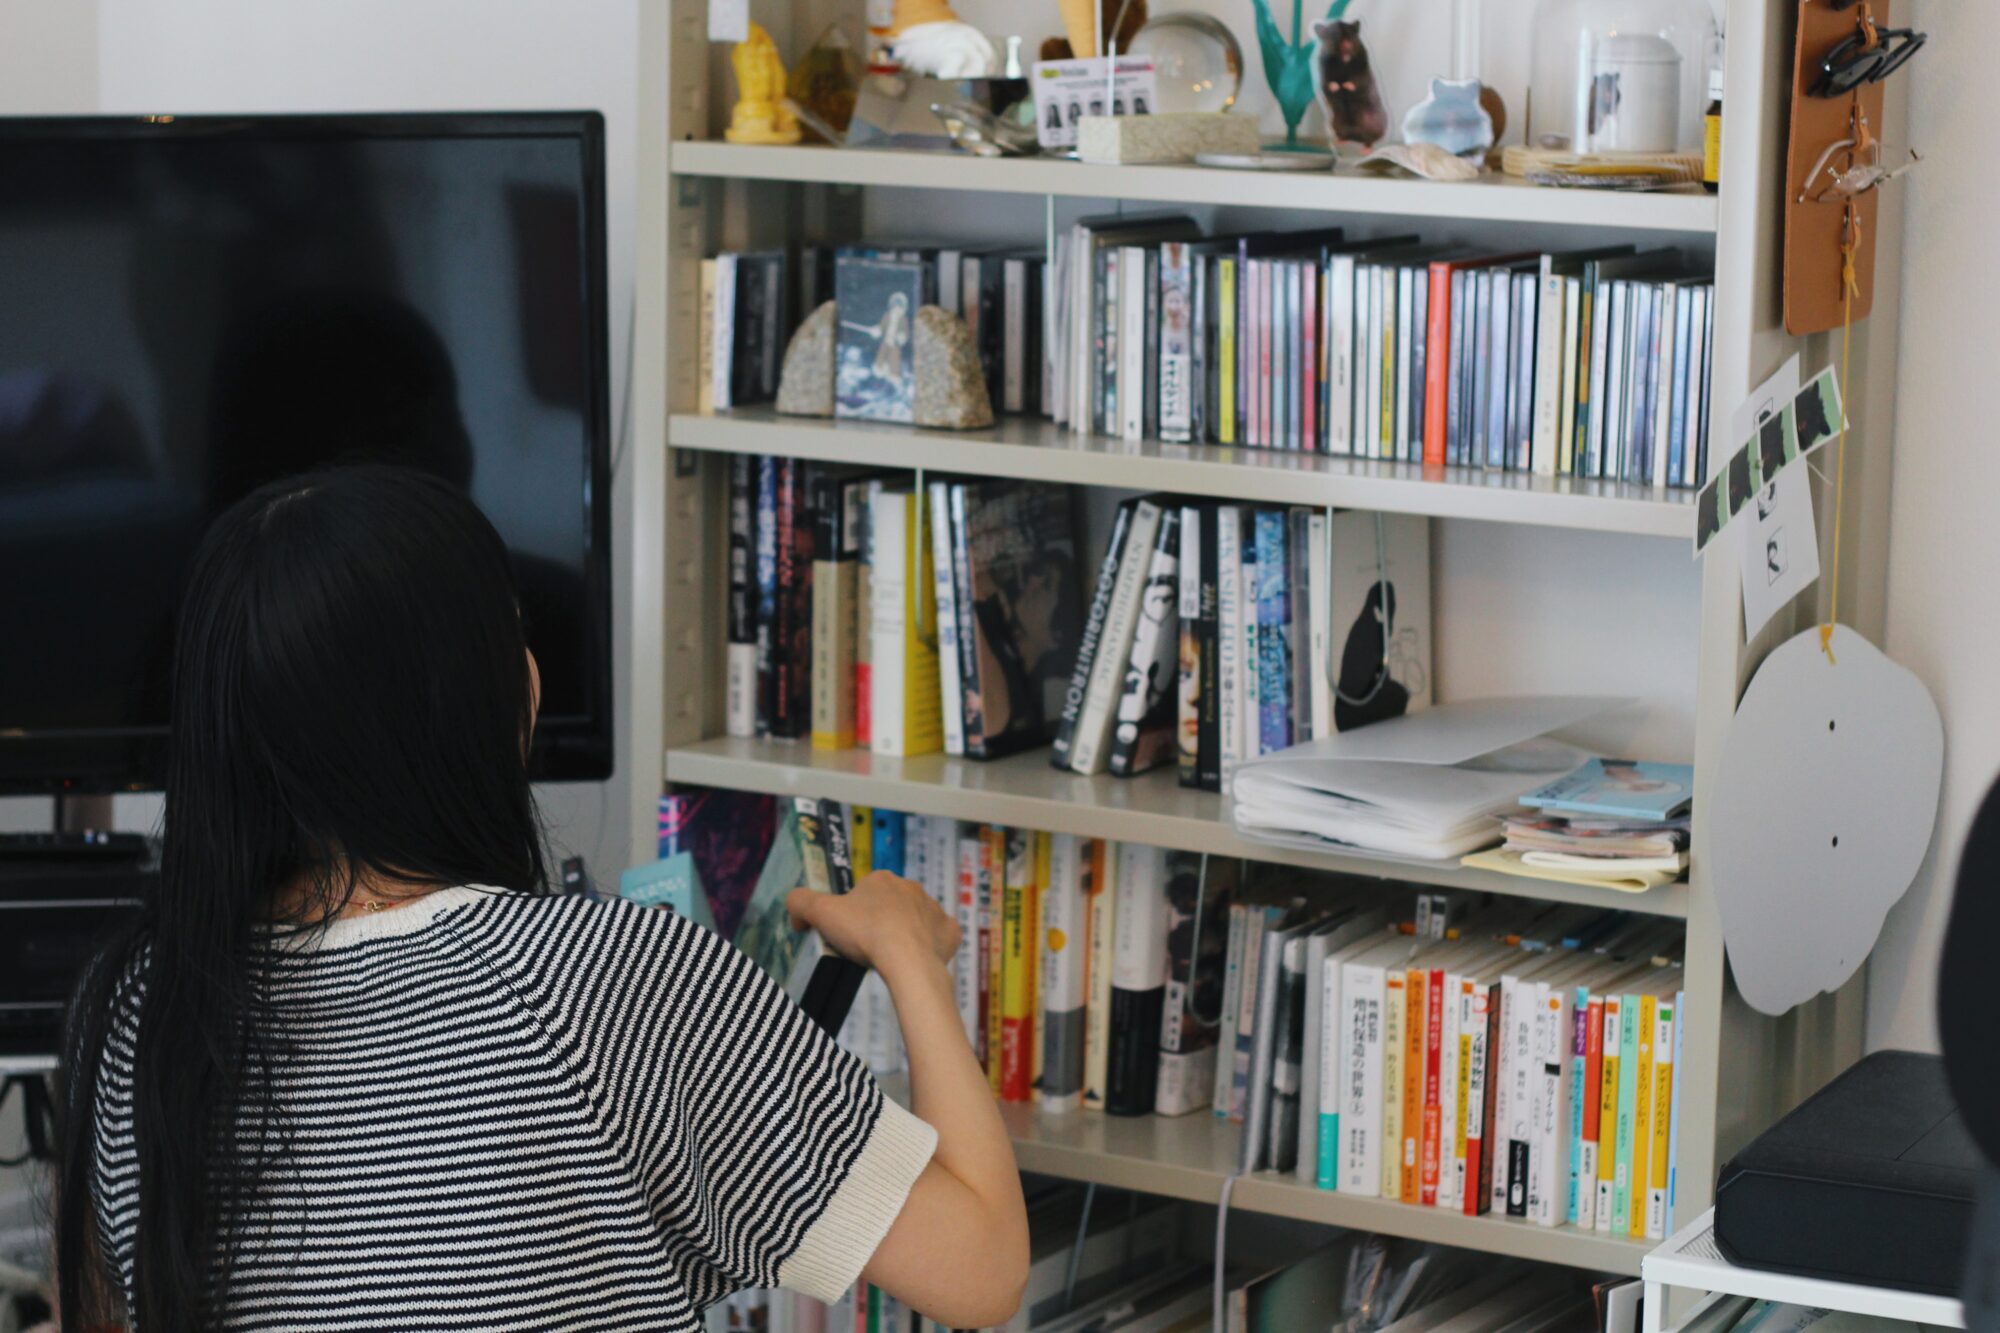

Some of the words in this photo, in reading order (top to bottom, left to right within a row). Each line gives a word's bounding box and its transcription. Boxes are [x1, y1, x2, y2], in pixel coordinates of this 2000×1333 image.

[1100, 540, 1142, 689] NYMPHOMANIAC
[1352, 997, 1367, 1099] 増村保造の世界
[1367, 999, 1378, 1043] 映画監督
[1470, 1031, 1484, 1090] 文様博物館
